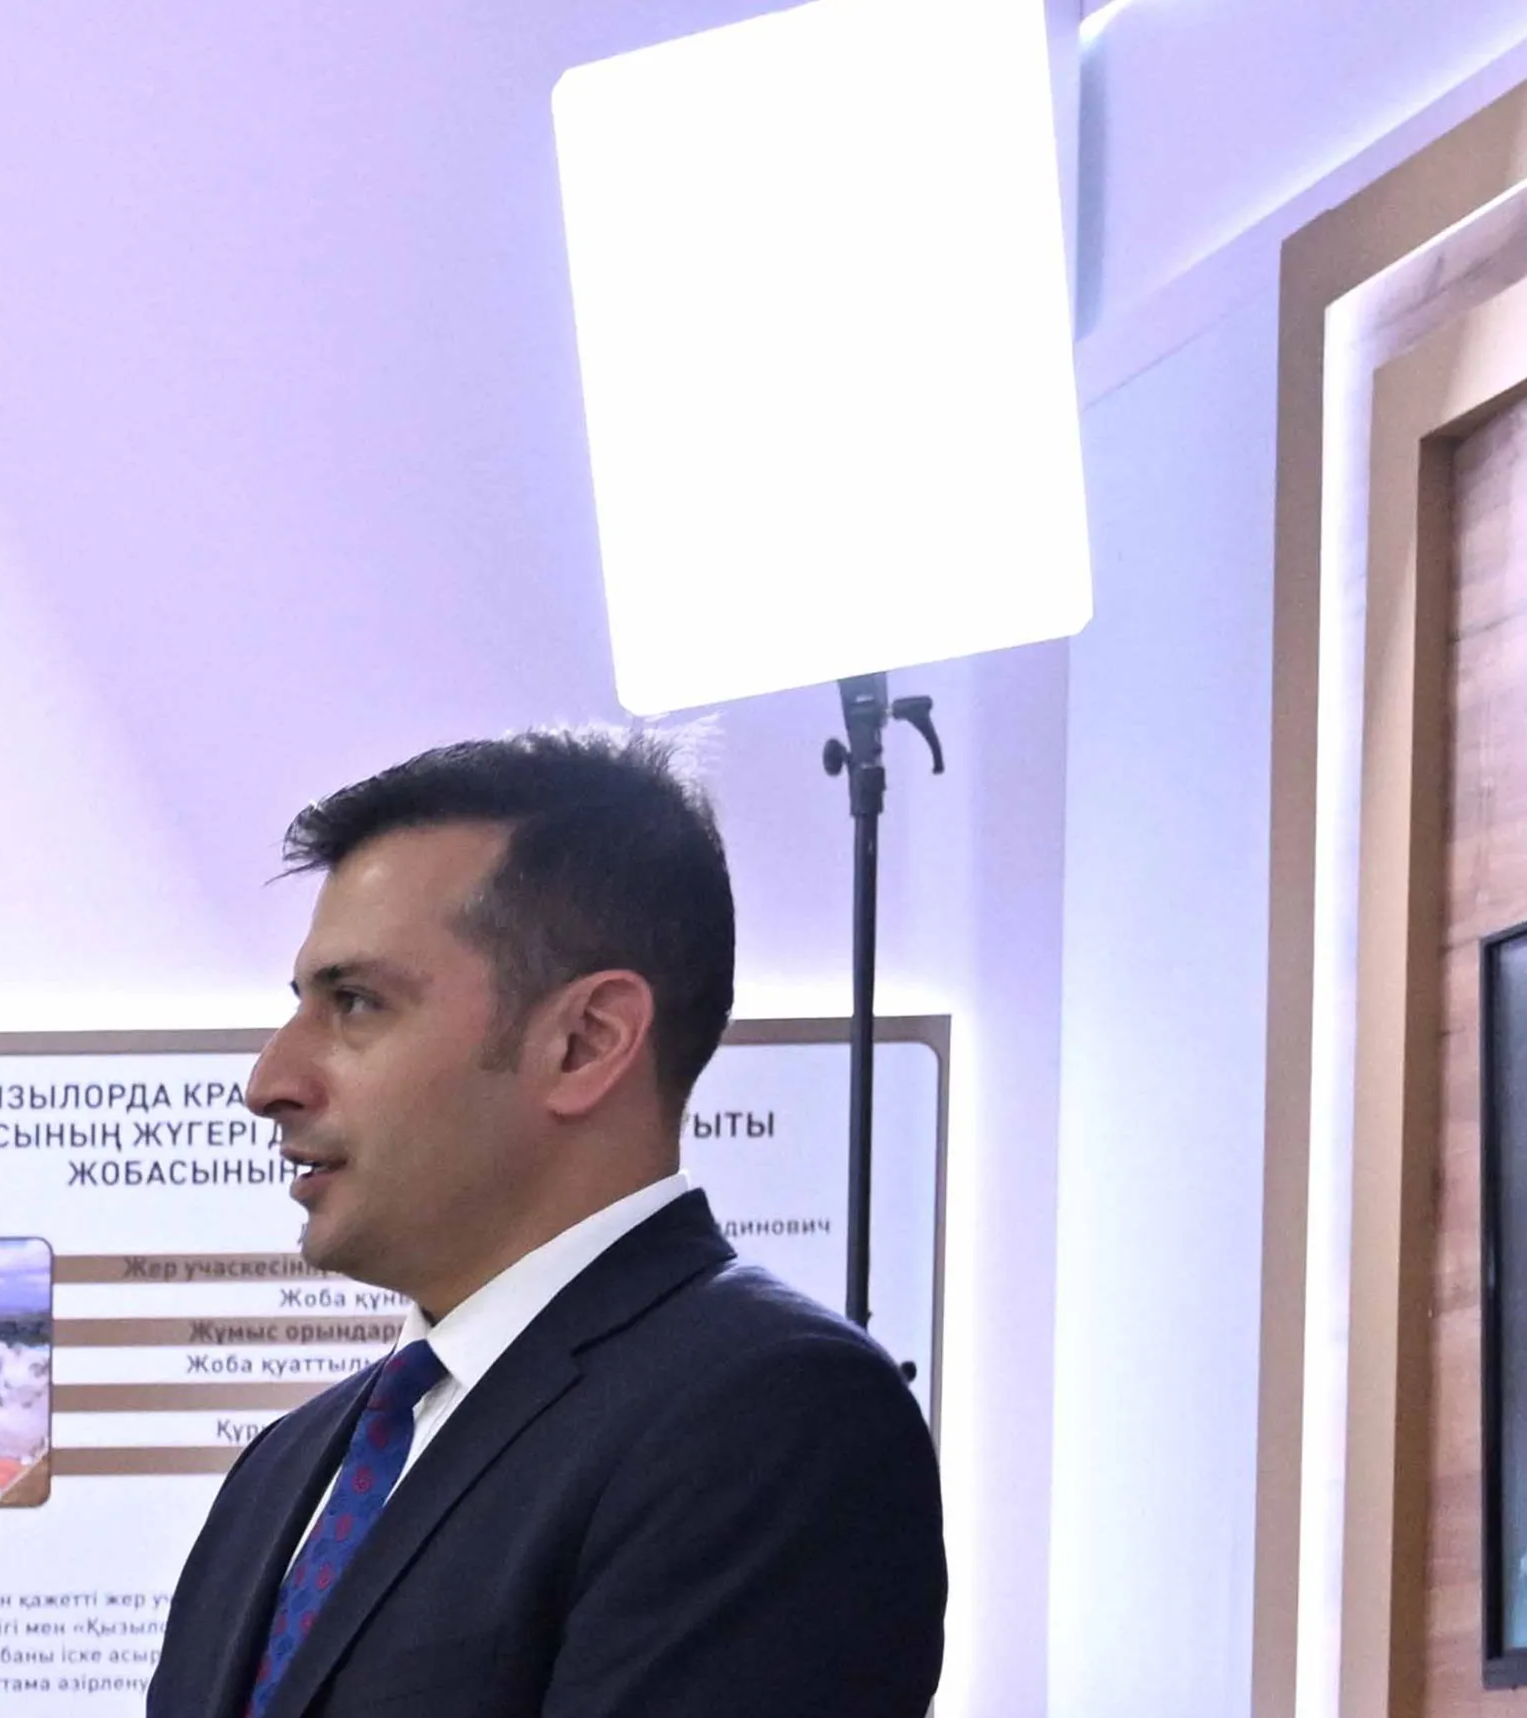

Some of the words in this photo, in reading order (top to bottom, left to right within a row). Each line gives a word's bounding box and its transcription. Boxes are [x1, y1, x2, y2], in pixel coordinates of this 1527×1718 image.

[133, 1121, 256, 1147] ЖҮГЕРІ
[687, 1111, 774, 1138] ЫТЫ
[123, 1256, 177, 1280] Жер
[280, 1288, 345, 1308] Жоба
[286, 1322, 403, 1344] орындар
[187, 1354, 252, 1374] Жоба
[262, 1355, 369, 1376] қуаттыл
